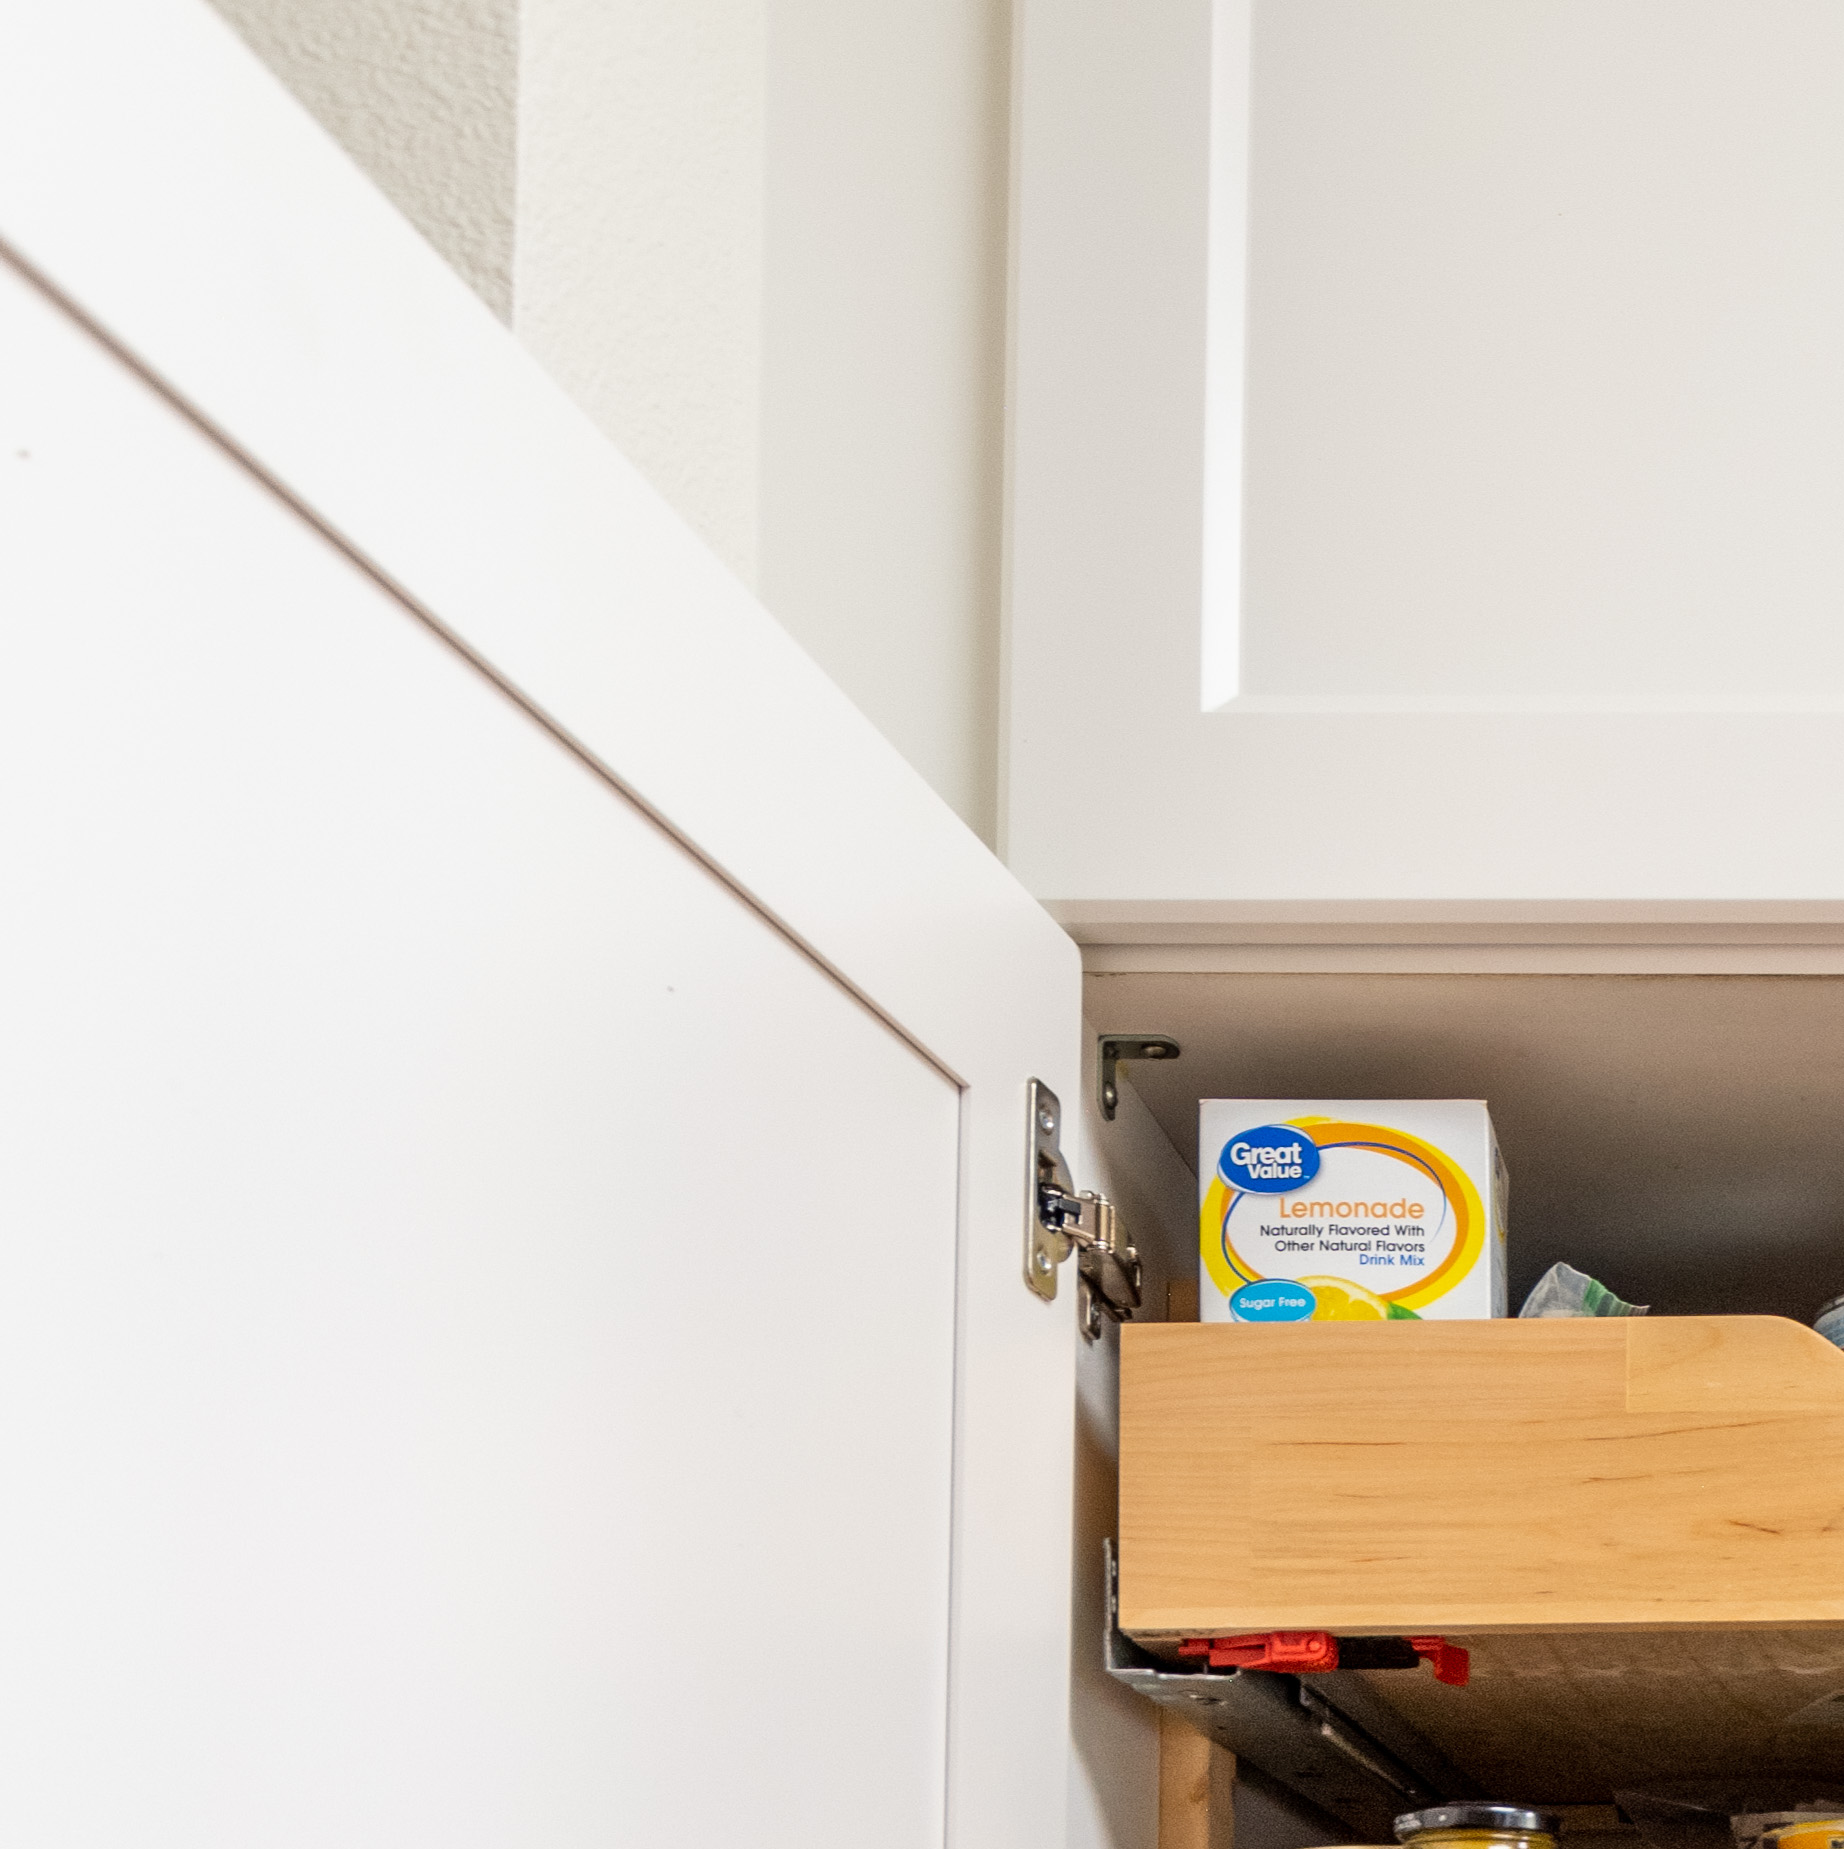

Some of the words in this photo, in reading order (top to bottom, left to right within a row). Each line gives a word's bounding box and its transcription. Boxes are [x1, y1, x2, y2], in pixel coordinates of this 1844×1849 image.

[1230, 1142, 1303, 1166] Great
[1248, 1162, 1303, 1180] Value
[1279, 1197, 1426, 1220] Lemonade
[1259, 1224, 1324, 1240] Naturally
[1329, 1224, 1391, 1237] Flavored
[1394, 1224, 1426, 1238] With
[1274, 1240, 1316, 1252] Other
[1319, 1240, 1372, 1252] Natural
[1376, 1240, 1426, 1253] Flavors
[1358, 1253, 1396, 1267] Drink
[1399, 1253, 1426, 1267] Mix
[1239, 1296, 1277, 1311] Sugar
[1278, 1296, 1307, 1308] Free
